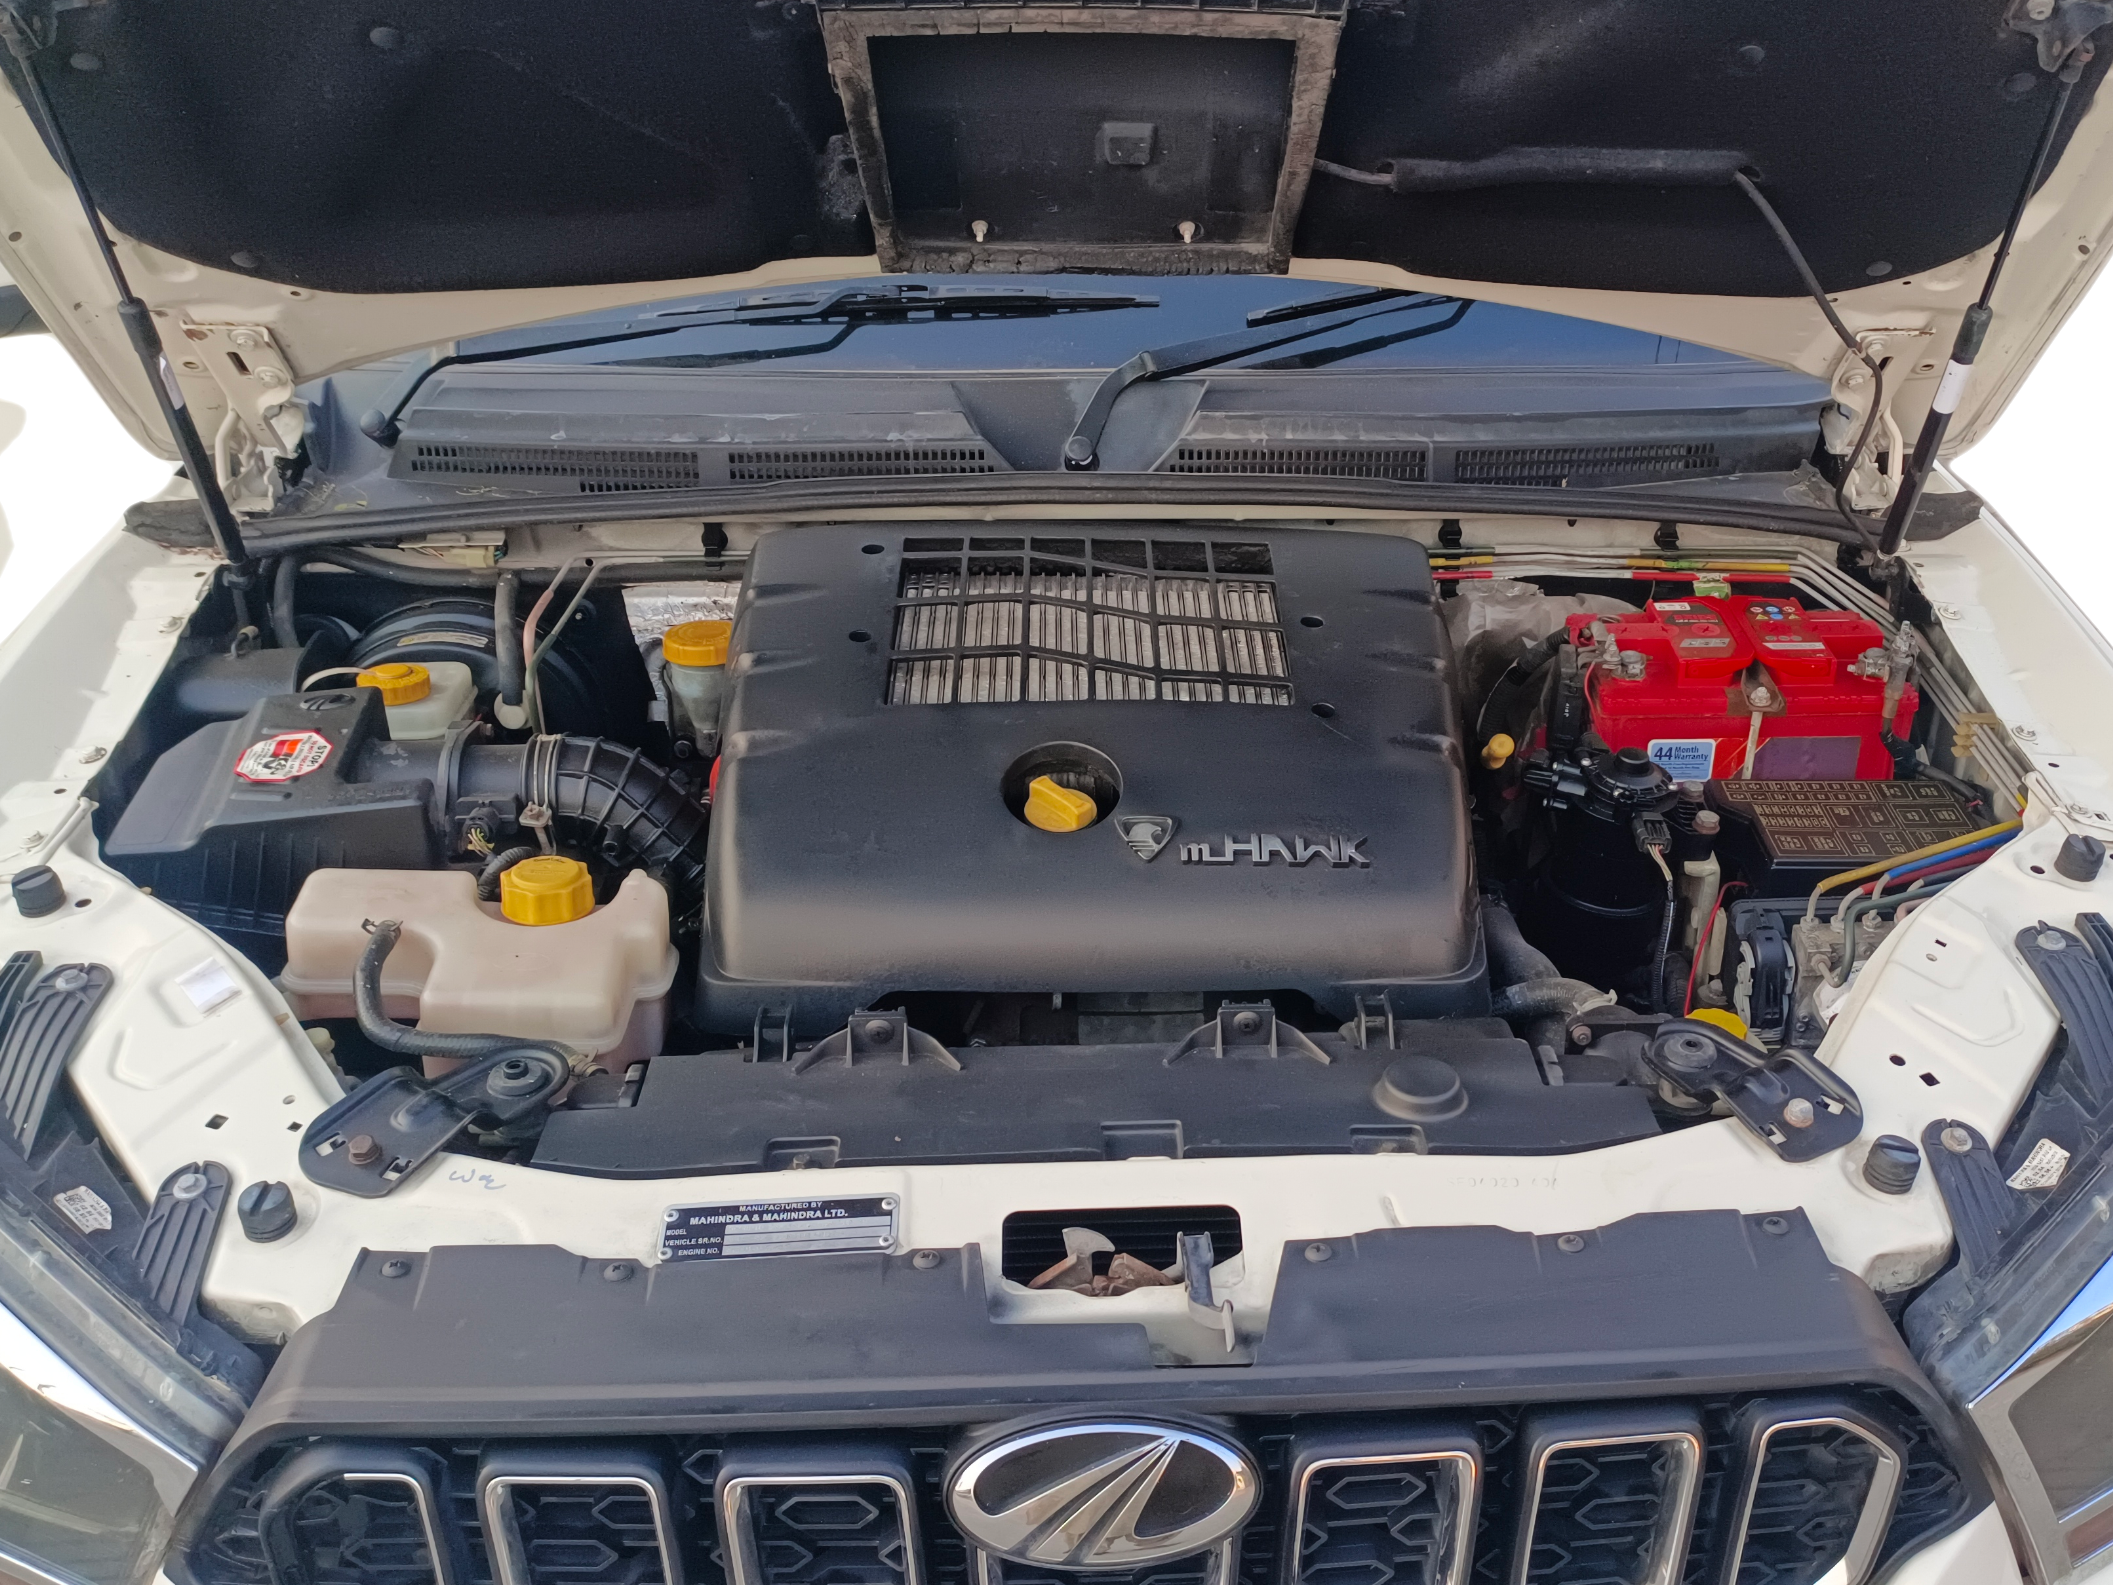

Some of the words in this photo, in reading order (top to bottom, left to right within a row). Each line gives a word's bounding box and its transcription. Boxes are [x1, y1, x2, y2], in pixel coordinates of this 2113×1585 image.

[1653, 747, 1673, 760] 44
[1675, 746, 1699, 754] Month
[1674, 753, 1709, 761] Warranty
[739, 1202, 809, 1212] MANUFACTURED
[811, 1201, 822, 1209] BY
[689, 1214, 749, 1225] MAHINDRA
[752, 1214, 759, 1222] &
[762, 1210, 821, 1221] MAHINDRA
[825, 1208, 848, 1218] LTD.
[666, 1228, 687, 1236] MODEL
[665, 1237, 696, 1246] VEHICLE
[678, 1247, 705, 1256] ENGINE
[706, 1247, 720, 1255] NO.
